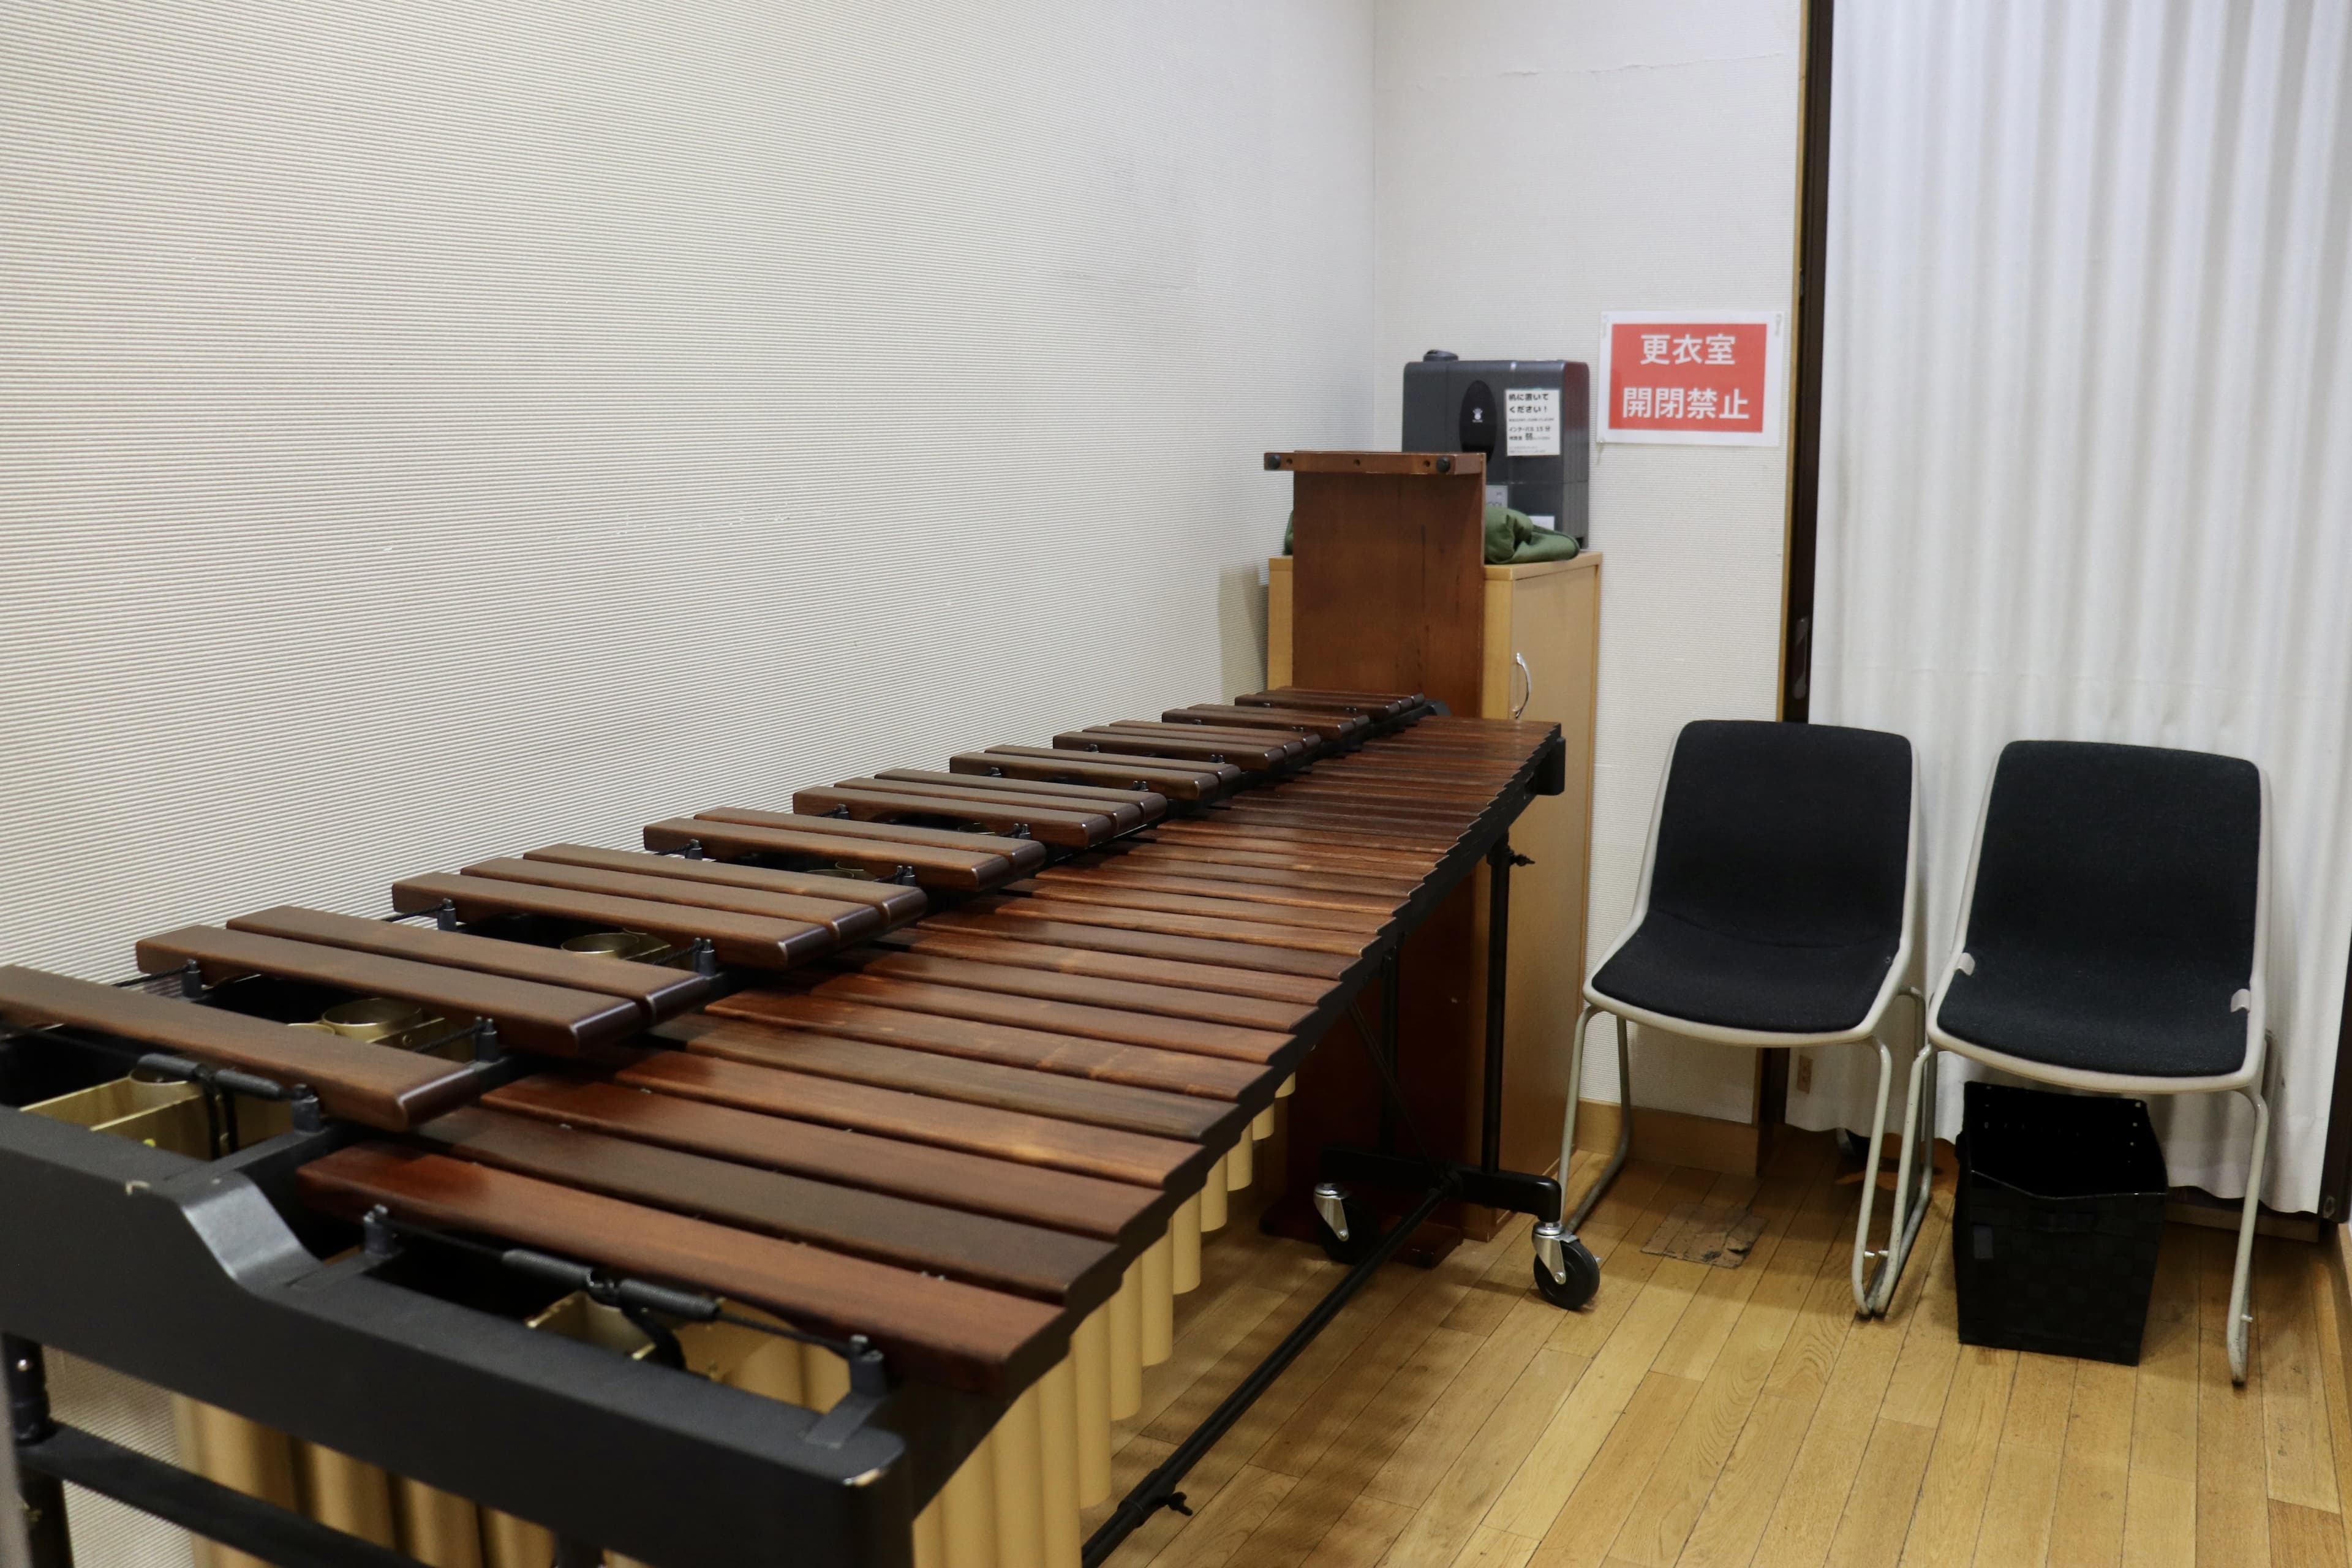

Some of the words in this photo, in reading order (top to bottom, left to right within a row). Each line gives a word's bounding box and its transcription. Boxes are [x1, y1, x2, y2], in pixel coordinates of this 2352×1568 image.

[1640, 333, 1735, 365] 更衣室
[1623, 387, 1749, 420] 開閉禁止
